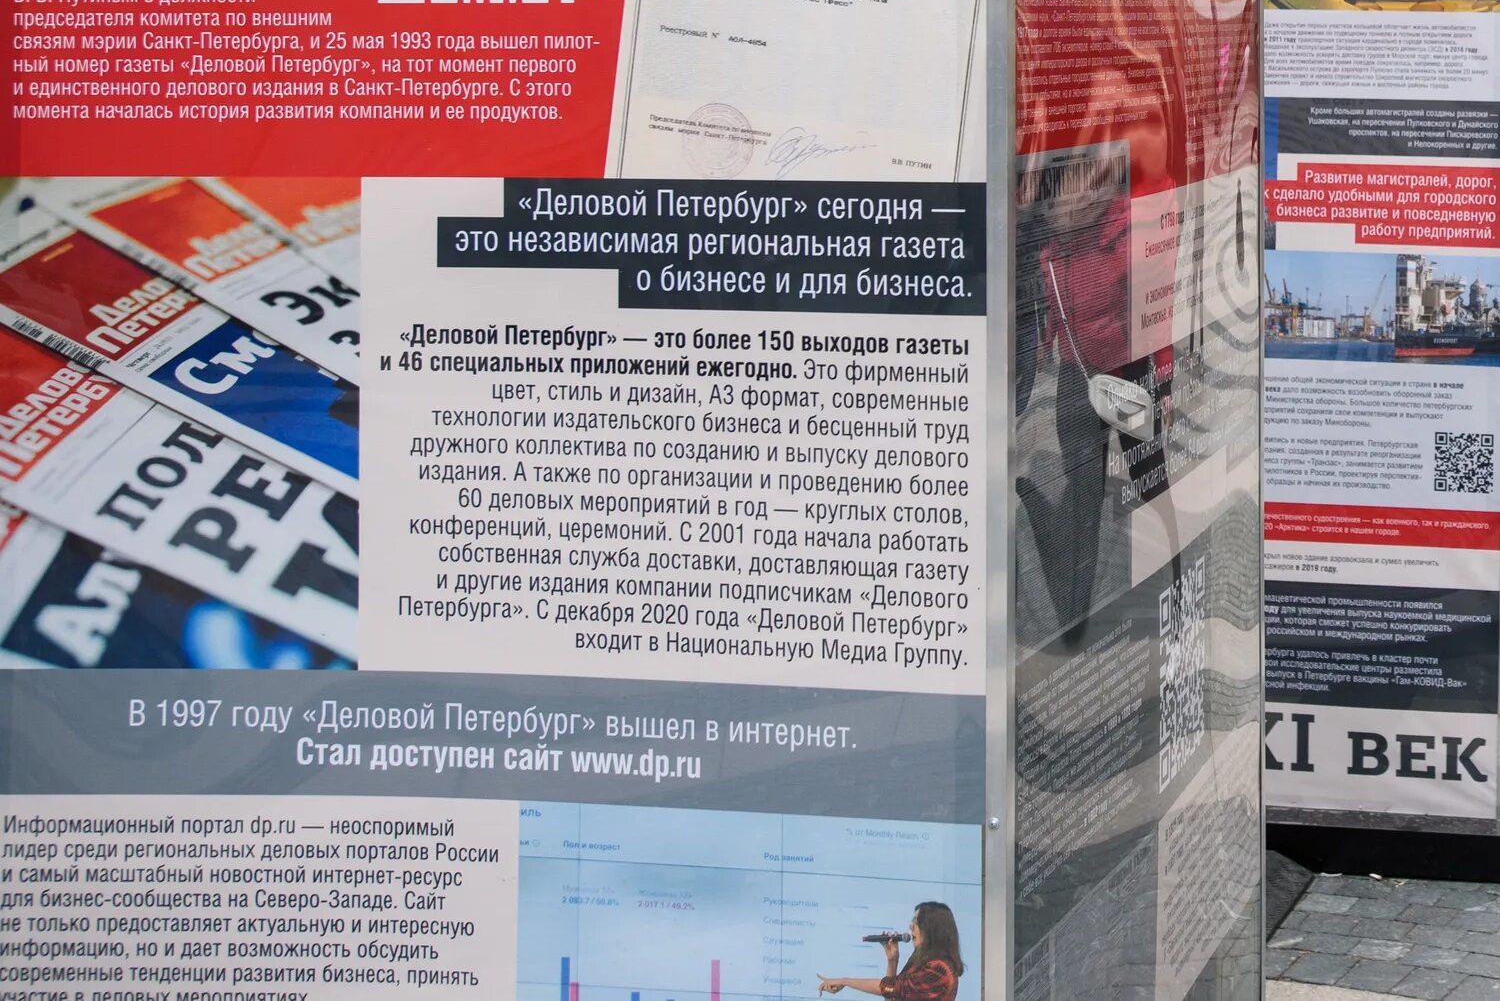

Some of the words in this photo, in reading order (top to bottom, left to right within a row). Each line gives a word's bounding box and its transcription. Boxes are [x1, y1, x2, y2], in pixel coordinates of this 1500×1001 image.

[906, 160, 932, 170] ПУТИН
[1306, 170, 1363, 184] Развитие
[1368, 174, 1451, 188] магистралей,
[1455, 177, 1496, 190] дорог,
[519, 188, 646, 220] «Деловой
[658, 190, 807, 224] Петербург»
[818, 198, 922, 224] сегодня
[1273, 189, 1324, 201] сделало
[1328, 188, 1393, 203] удобными
[1397, 192, 1420, 204] для
[1424, 193, 1496, 206] городского
[1277, 204, 1326, 217] бизнеса
[1331, 207, 1388, 220] развитие
[1392, 210, 1400, 219] и
[1404, 210, 1496, 224] повседневную
[1362, 224, 1404, 240] работу
[1409, 225, 1495, 241] предприятий.
[456, 231, 498, 251] это
[510, 231, 678, 253] независимая
[689, 234, 870, 260] региональная
[882, 237, 964, 259] газета
[637, 270, 650, 290] о
[661, 264, 765, 293] бизнесе
[776, 273, 789, 293] и
[800, 273, 846, 298] для
[857, 268, 971, 297] бизнеса.
[130, 700, 145, 726] В
[158, 700, 222, 726] 1997
[232, 706, 292, 733] году
[304, 701, 434, 733] «Деловой
[446, 703, 595, 748] Петербург»
[607, 716, 694, 740] вышел
[706, 720, 718, 741] в
[730, 722, 856, 752] интернет.
[298, 737, 360, 765] Стал
[370, 745, 494, 773] доступен
[504, 744, 563, 771] сайт
[571, 749, 700, 782] www.dp.ru
[1347, 731, 1488, 782] ВЕК
[4, 815, 174, 837] Информационный
[182, 820, 243, 837] портал
[251, 816, 295, 838] dp.ru
[331, 819, 454, 839] неоспоримый
[563, 840, 580, 850] Пол
